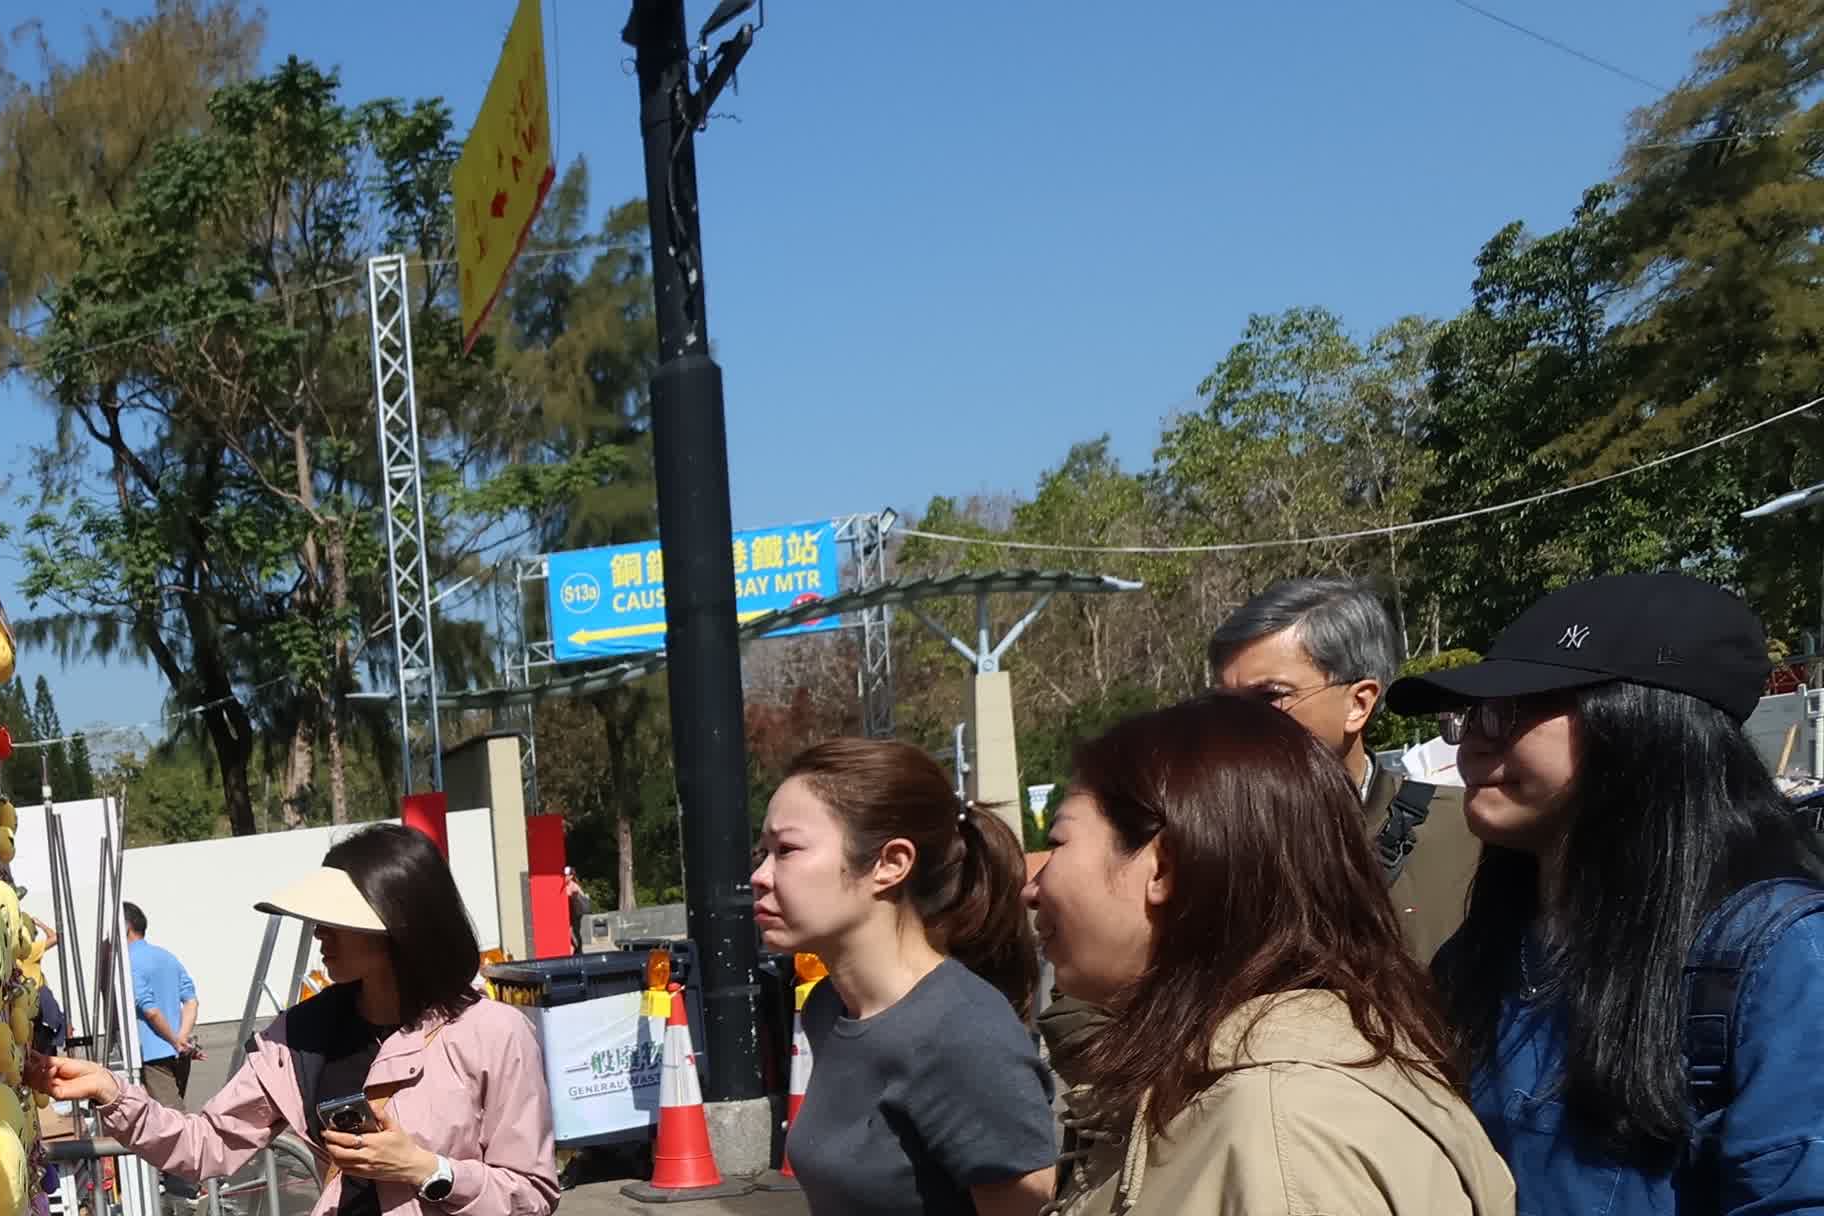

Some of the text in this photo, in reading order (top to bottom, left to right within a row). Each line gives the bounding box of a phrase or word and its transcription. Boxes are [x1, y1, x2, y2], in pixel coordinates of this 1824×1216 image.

[564, 585, 598, 604] S13a
[612, 589, 667, 613] CAUS
[774, 569, 821, 594] MTR
[1556, 623, 1590, 649] NY
[629, 1074, 661, 1086] WAST
